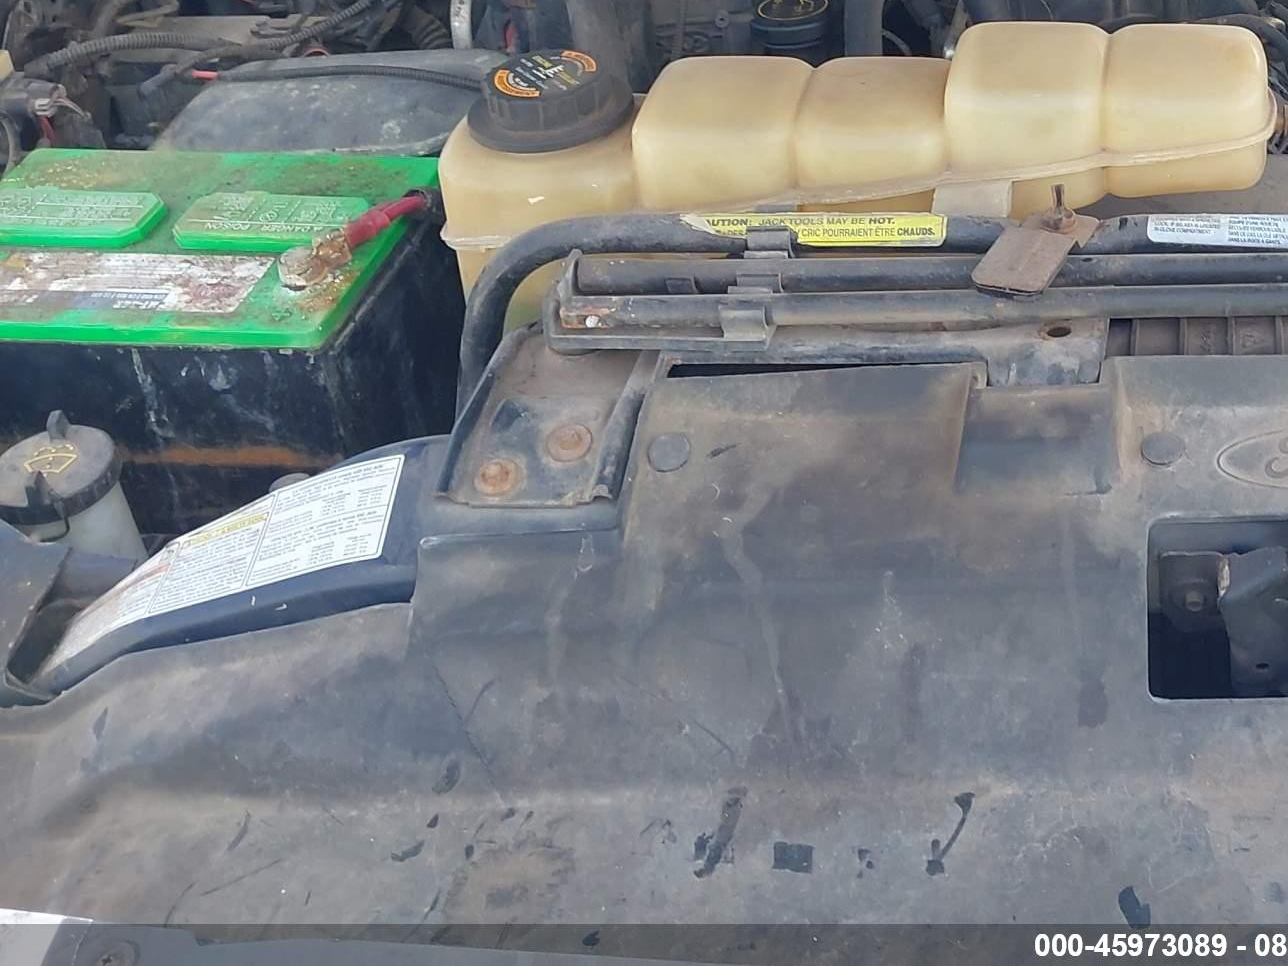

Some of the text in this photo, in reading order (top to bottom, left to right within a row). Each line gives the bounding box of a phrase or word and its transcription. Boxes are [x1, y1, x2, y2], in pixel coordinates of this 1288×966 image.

[204, 222, 251, 231] POISON
[758, 218, 786, 226] JACK
[801, 226, 935, 237] CRIC POURRAIENT ÊTRE CHAUDS.
